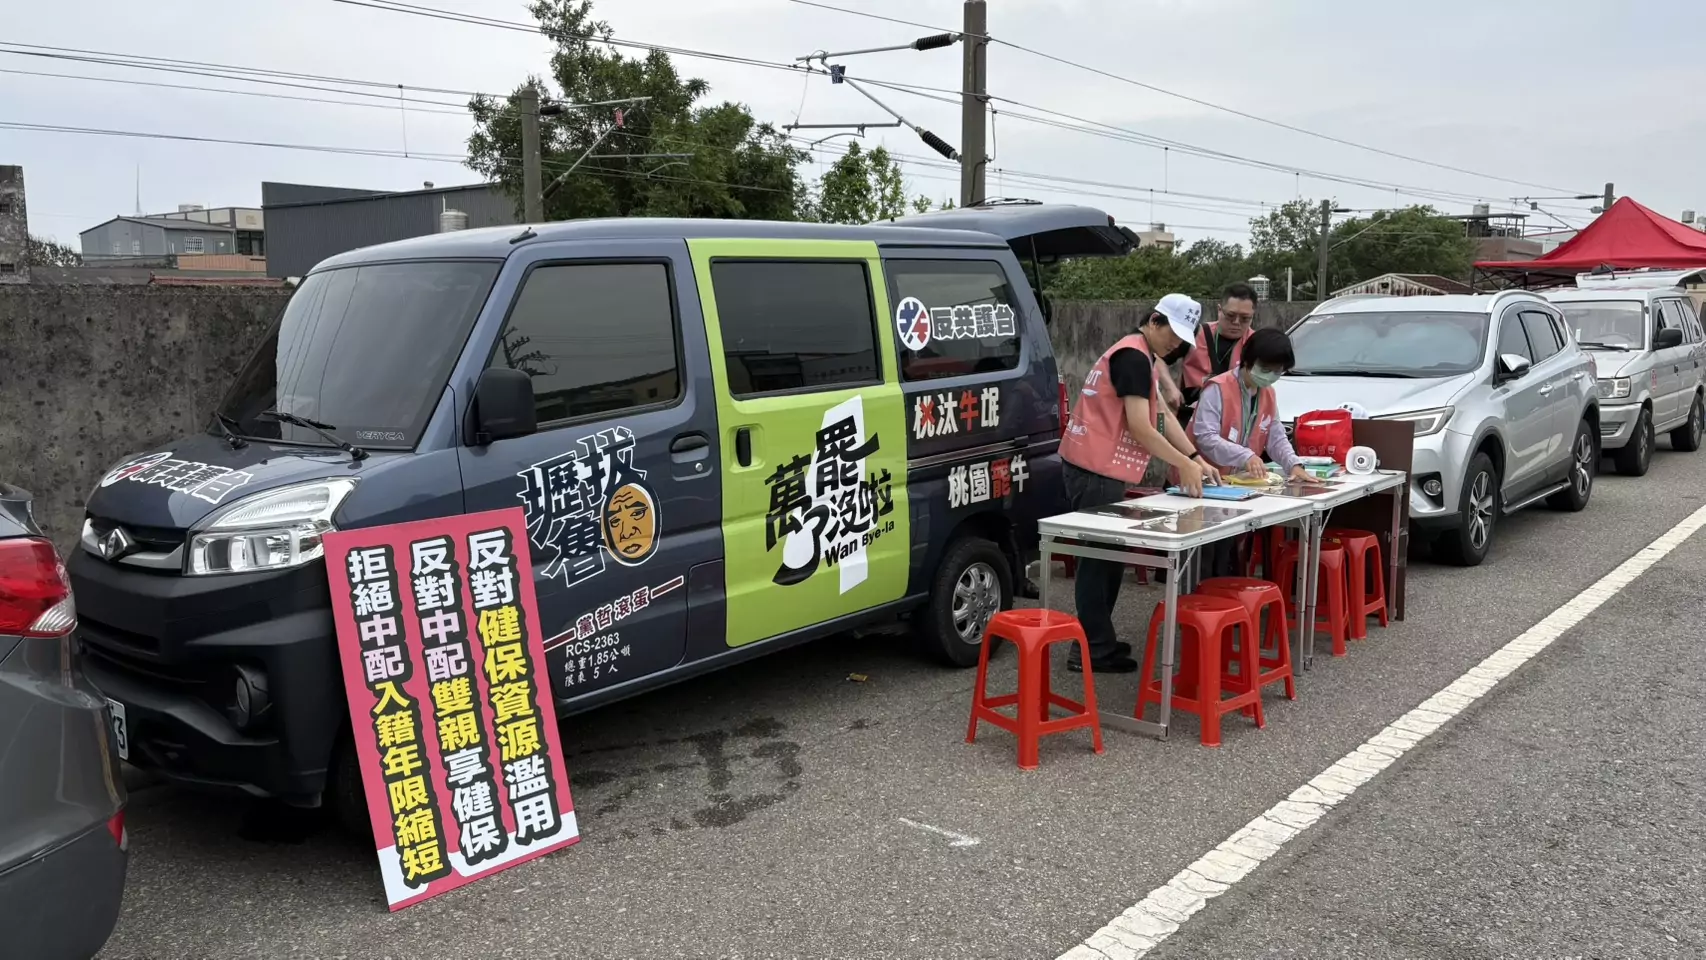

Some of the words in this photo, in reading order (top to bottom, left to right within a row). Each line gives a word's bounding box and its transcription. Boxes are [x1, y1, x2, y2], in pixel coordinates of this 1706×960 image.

[356, 430, 405, 441] VERYCA
[825, 540, 858, 567] Wan
[861, 520, 895, 547] Bye-la
[348, 547, 444, 882] 拒絕中配入籍年限縮短
[411, 537, 502, 862] 反對中配雙親享健保
[468, 529, 556, 838] 反對健保資源濫用
[565, 632, 620, 658] RCS-2363
